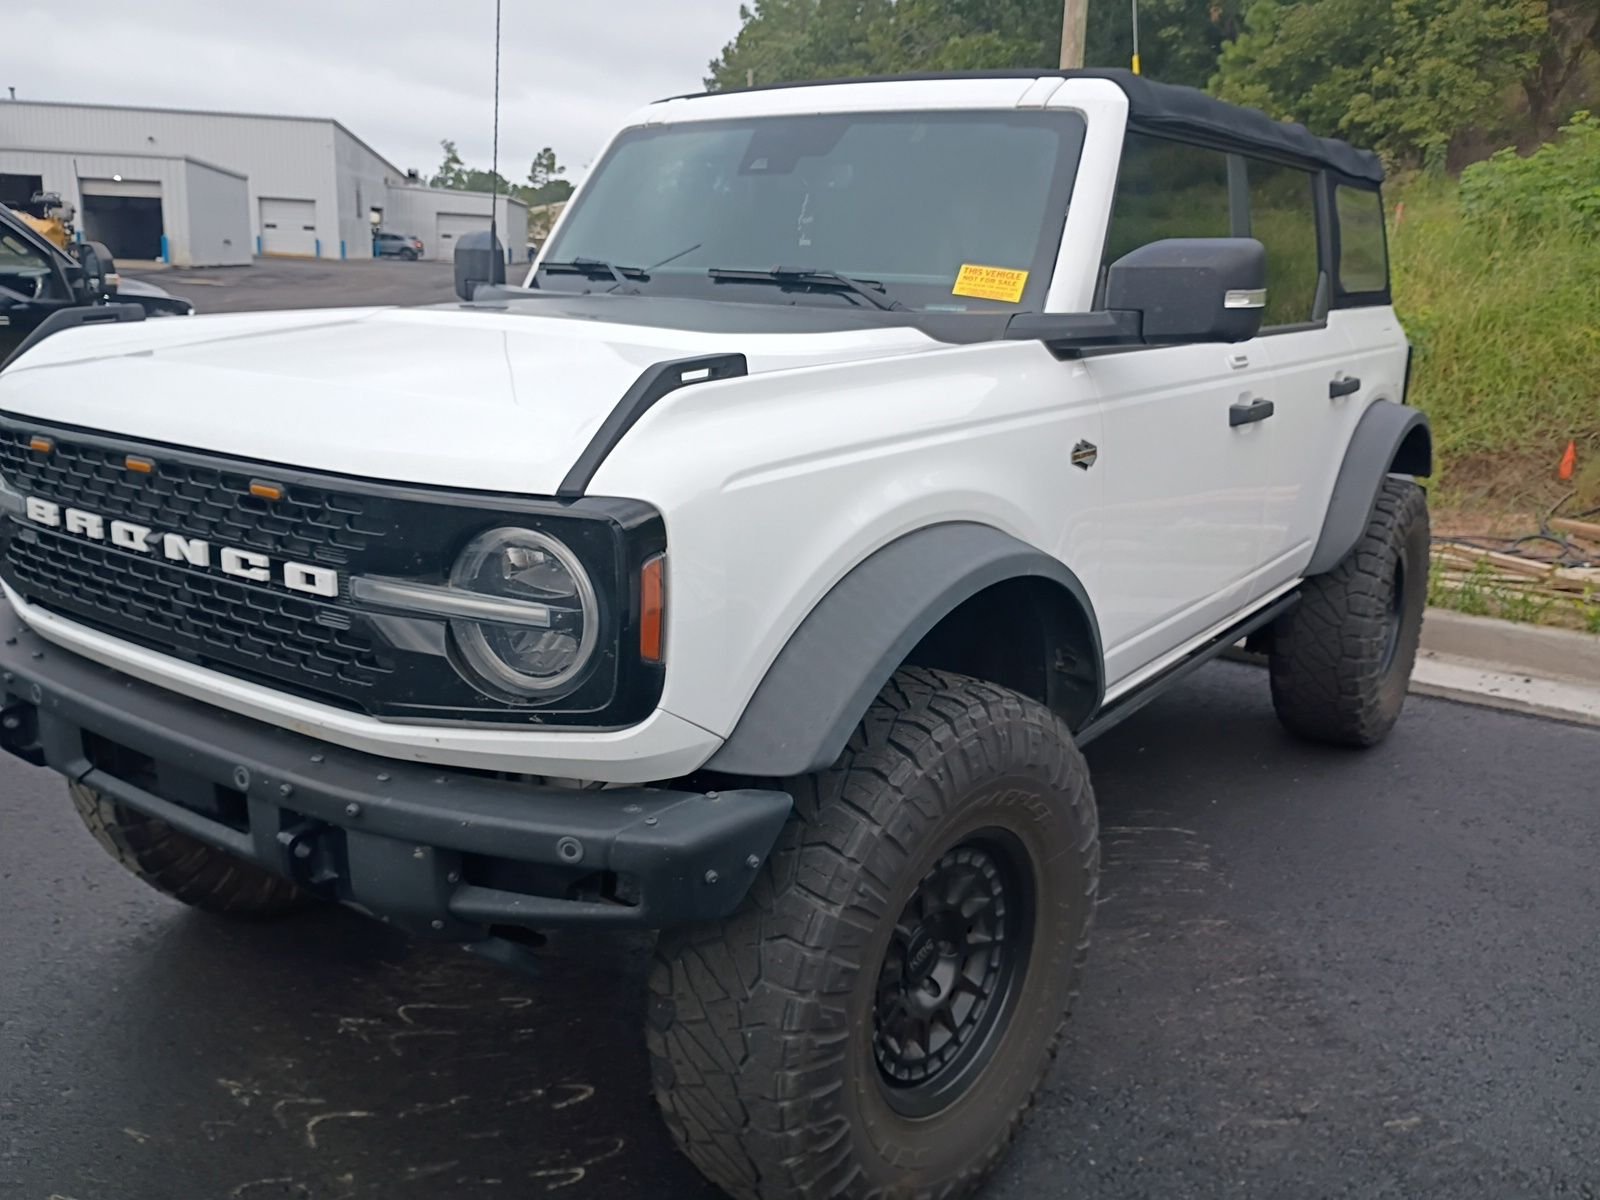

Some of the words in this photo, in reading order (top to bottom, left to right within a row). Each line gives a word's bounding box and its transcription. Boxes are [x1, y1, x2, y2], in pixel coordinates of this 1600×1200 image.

[964, 267, 982, 275] THIS
[985, 269, 1023, 280] VEHICLE
[980, 276, 997, 284] FOR
[998, 279, 1017, 287] SALE
[26, 496, 339, 597] BRONCO
